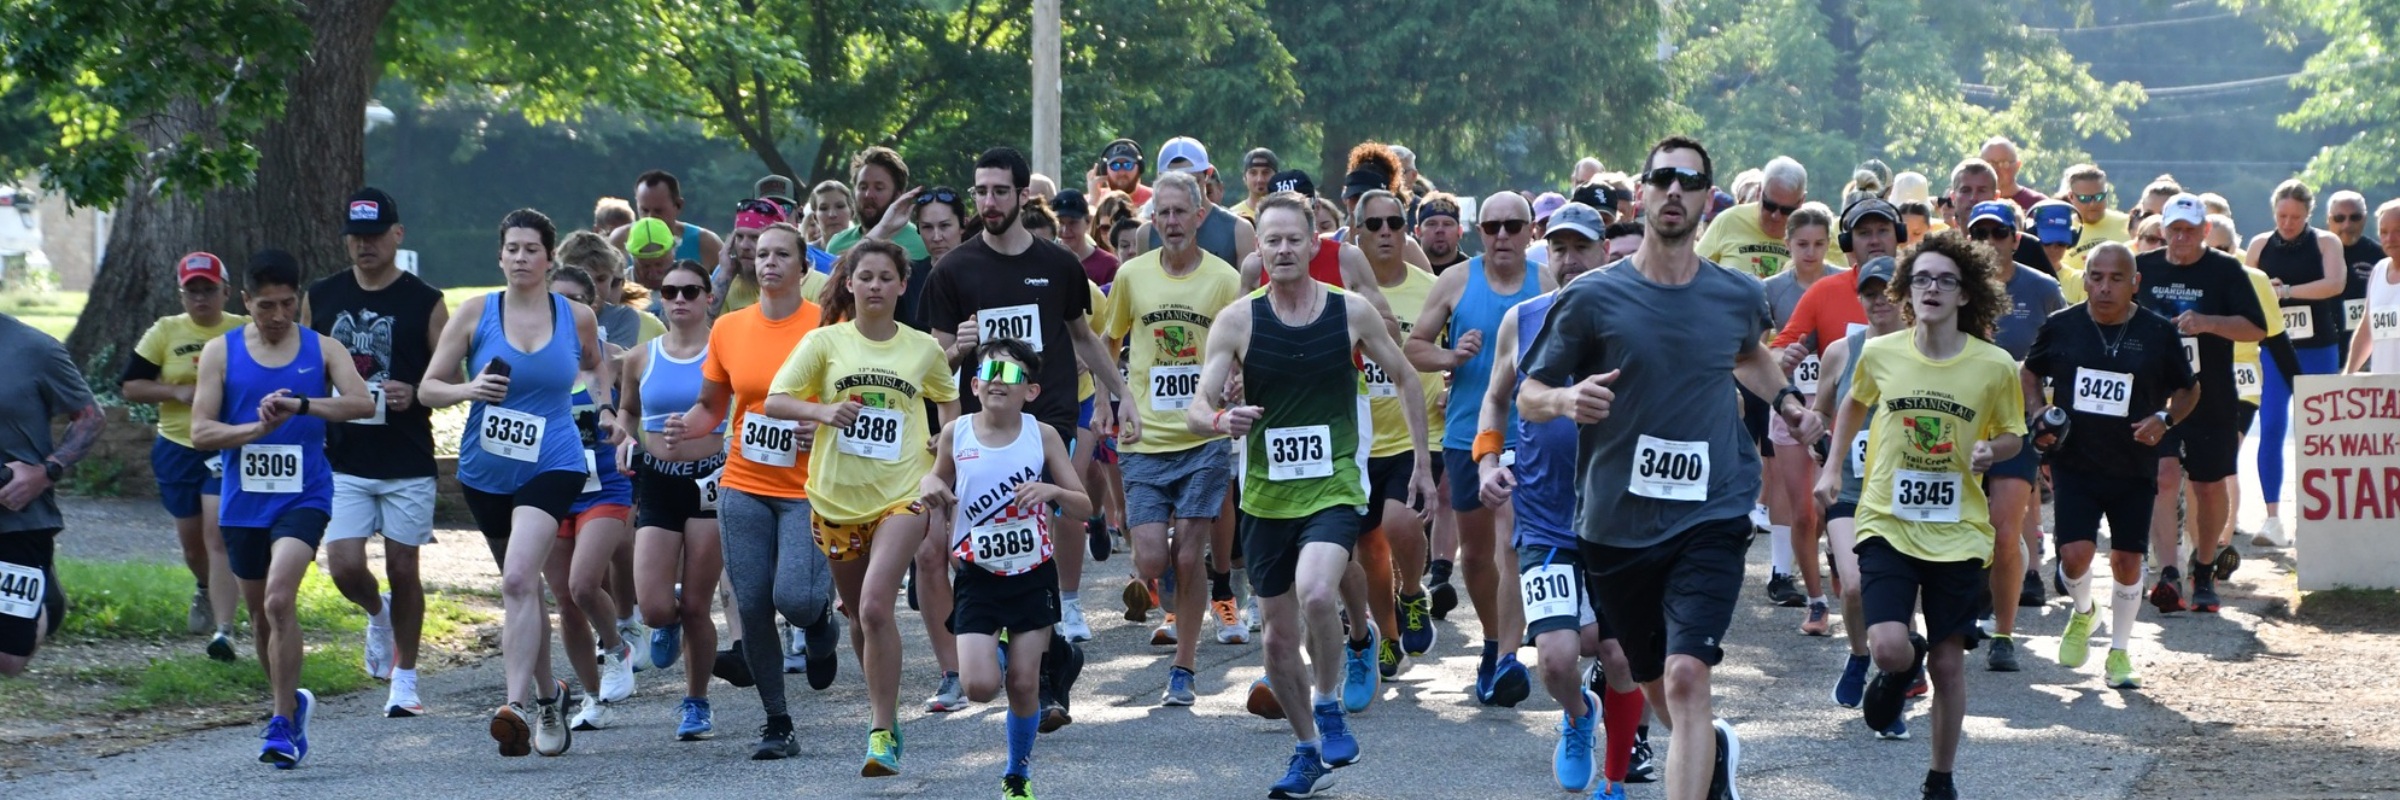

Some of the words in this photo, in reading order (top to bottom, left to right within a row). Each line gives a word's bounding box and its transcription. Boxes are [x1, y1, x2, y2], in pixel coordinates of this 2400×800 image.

[2152, 286, 2204, 298] GUARDIANS
[985, 314, 1032, 339] 2807
[2373, 311, 2397, 329] 3410
[871, 367, 898, 376] ANNUAL
[1364, 363, 1394, 384] 33
[2236, 368, 2256, 386] 38
[2080, 377, 2126, 402] 3426
[485, 415, 538, 446] 3339
[745, 422, 793, 452] 3408
[1273, 435, 1324, 463] 3373
[2304, 434, 2336, 457] 5K
[245, 453, 297, 477] 3309
[653, 459, 695, 476] NIKE
[697, 451, 727, 473] PRO
[1640, 448, 1703, 481] 3400
[964, 466, 1036, 522] INDIANA
[1899, 479, 1955, 506] 3345
[977, 528, 1035, 560] 3389
[0, 573, 40, 602] 440
[1525, 573, 1570, 606] 3310
